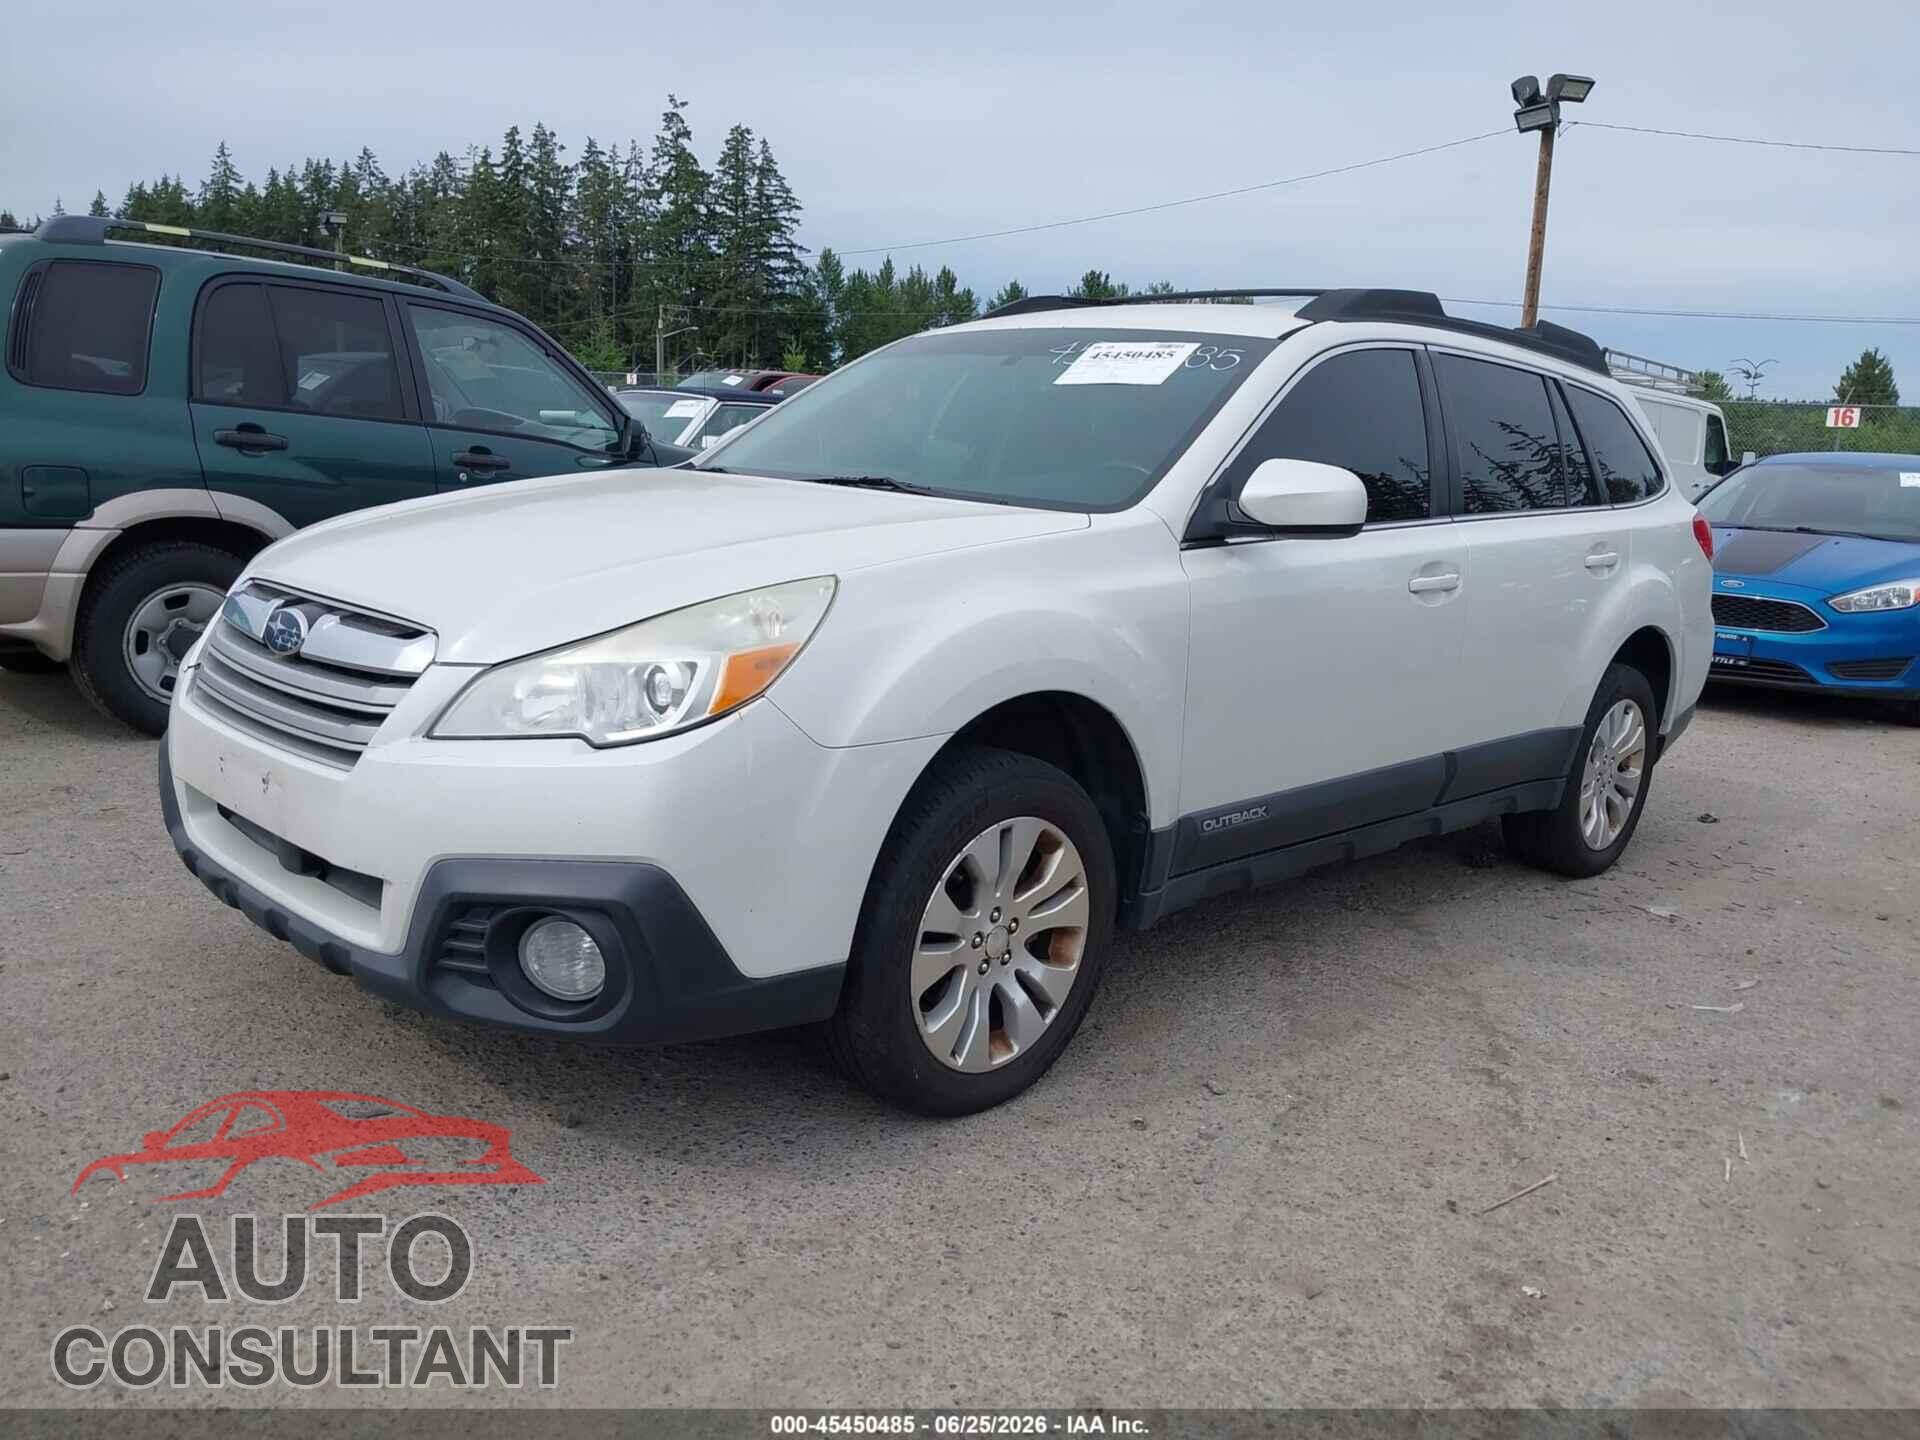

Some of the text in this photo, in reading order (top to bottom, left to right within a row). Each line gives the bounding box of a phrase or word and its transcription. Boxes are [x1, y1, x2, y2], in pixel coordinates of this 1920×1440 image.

[1089, 351, 1176, 360] 45450485
[1833, 409, 1854, 426] 16
[1203, 805, 1267, 831] OUTBACK
